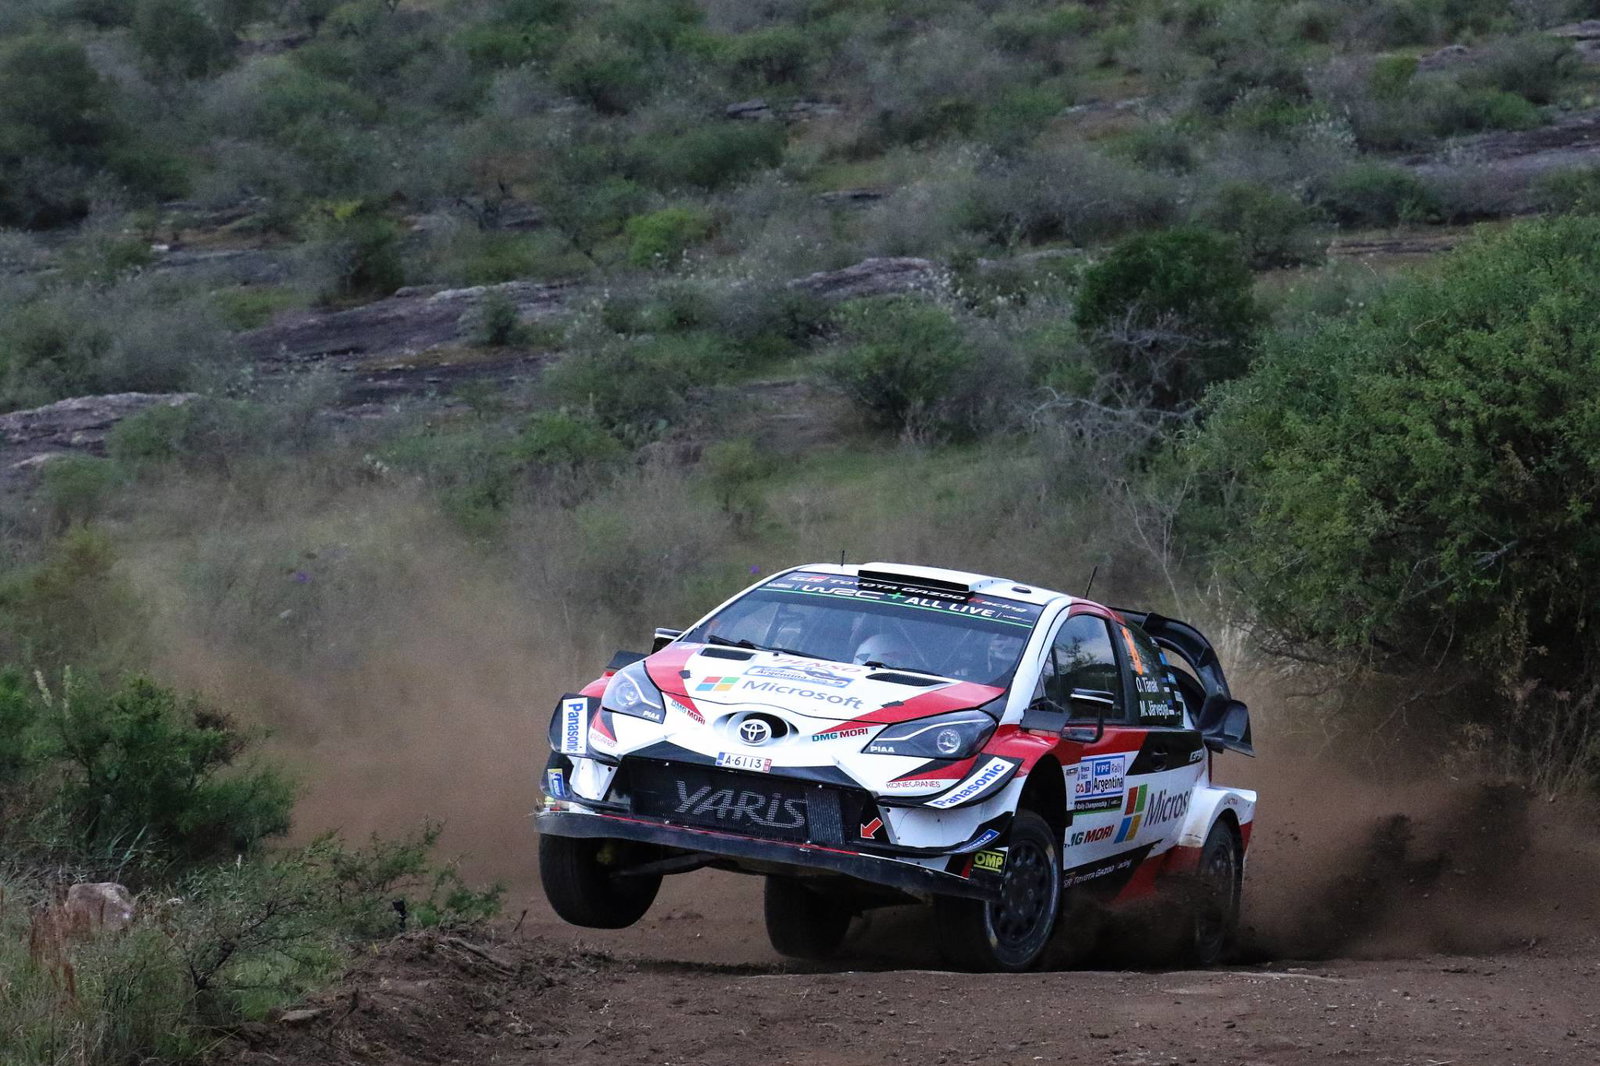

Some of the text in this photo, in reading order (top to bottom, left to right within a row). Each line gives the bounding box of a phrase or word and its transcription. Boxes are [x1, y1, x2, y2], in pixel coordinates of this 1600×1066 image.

[829, 579, 898, 591] TOYOTA
[901, 587, 967, 601] GAZOO
[967, 597, 1029, 613] Racing
[903, 596, 944, 609] ALL
[947, 603, 996, 618] LIVE
[741, 680, 865, 710] Microsoft
[642, 709, 661, 721] PIAA
[670, 700, 707, 726] DMG MORI
[811, 727, 869, 743] DMG MORI
[1096, 763, 1110, 774] YPF
[934, 762, 1006, 808] Panasonic
[1093, 774, 1123, 793] Argentina
[1083, 824, 1115, 844] MORI
[974, 852, 1004, 869] OMP
